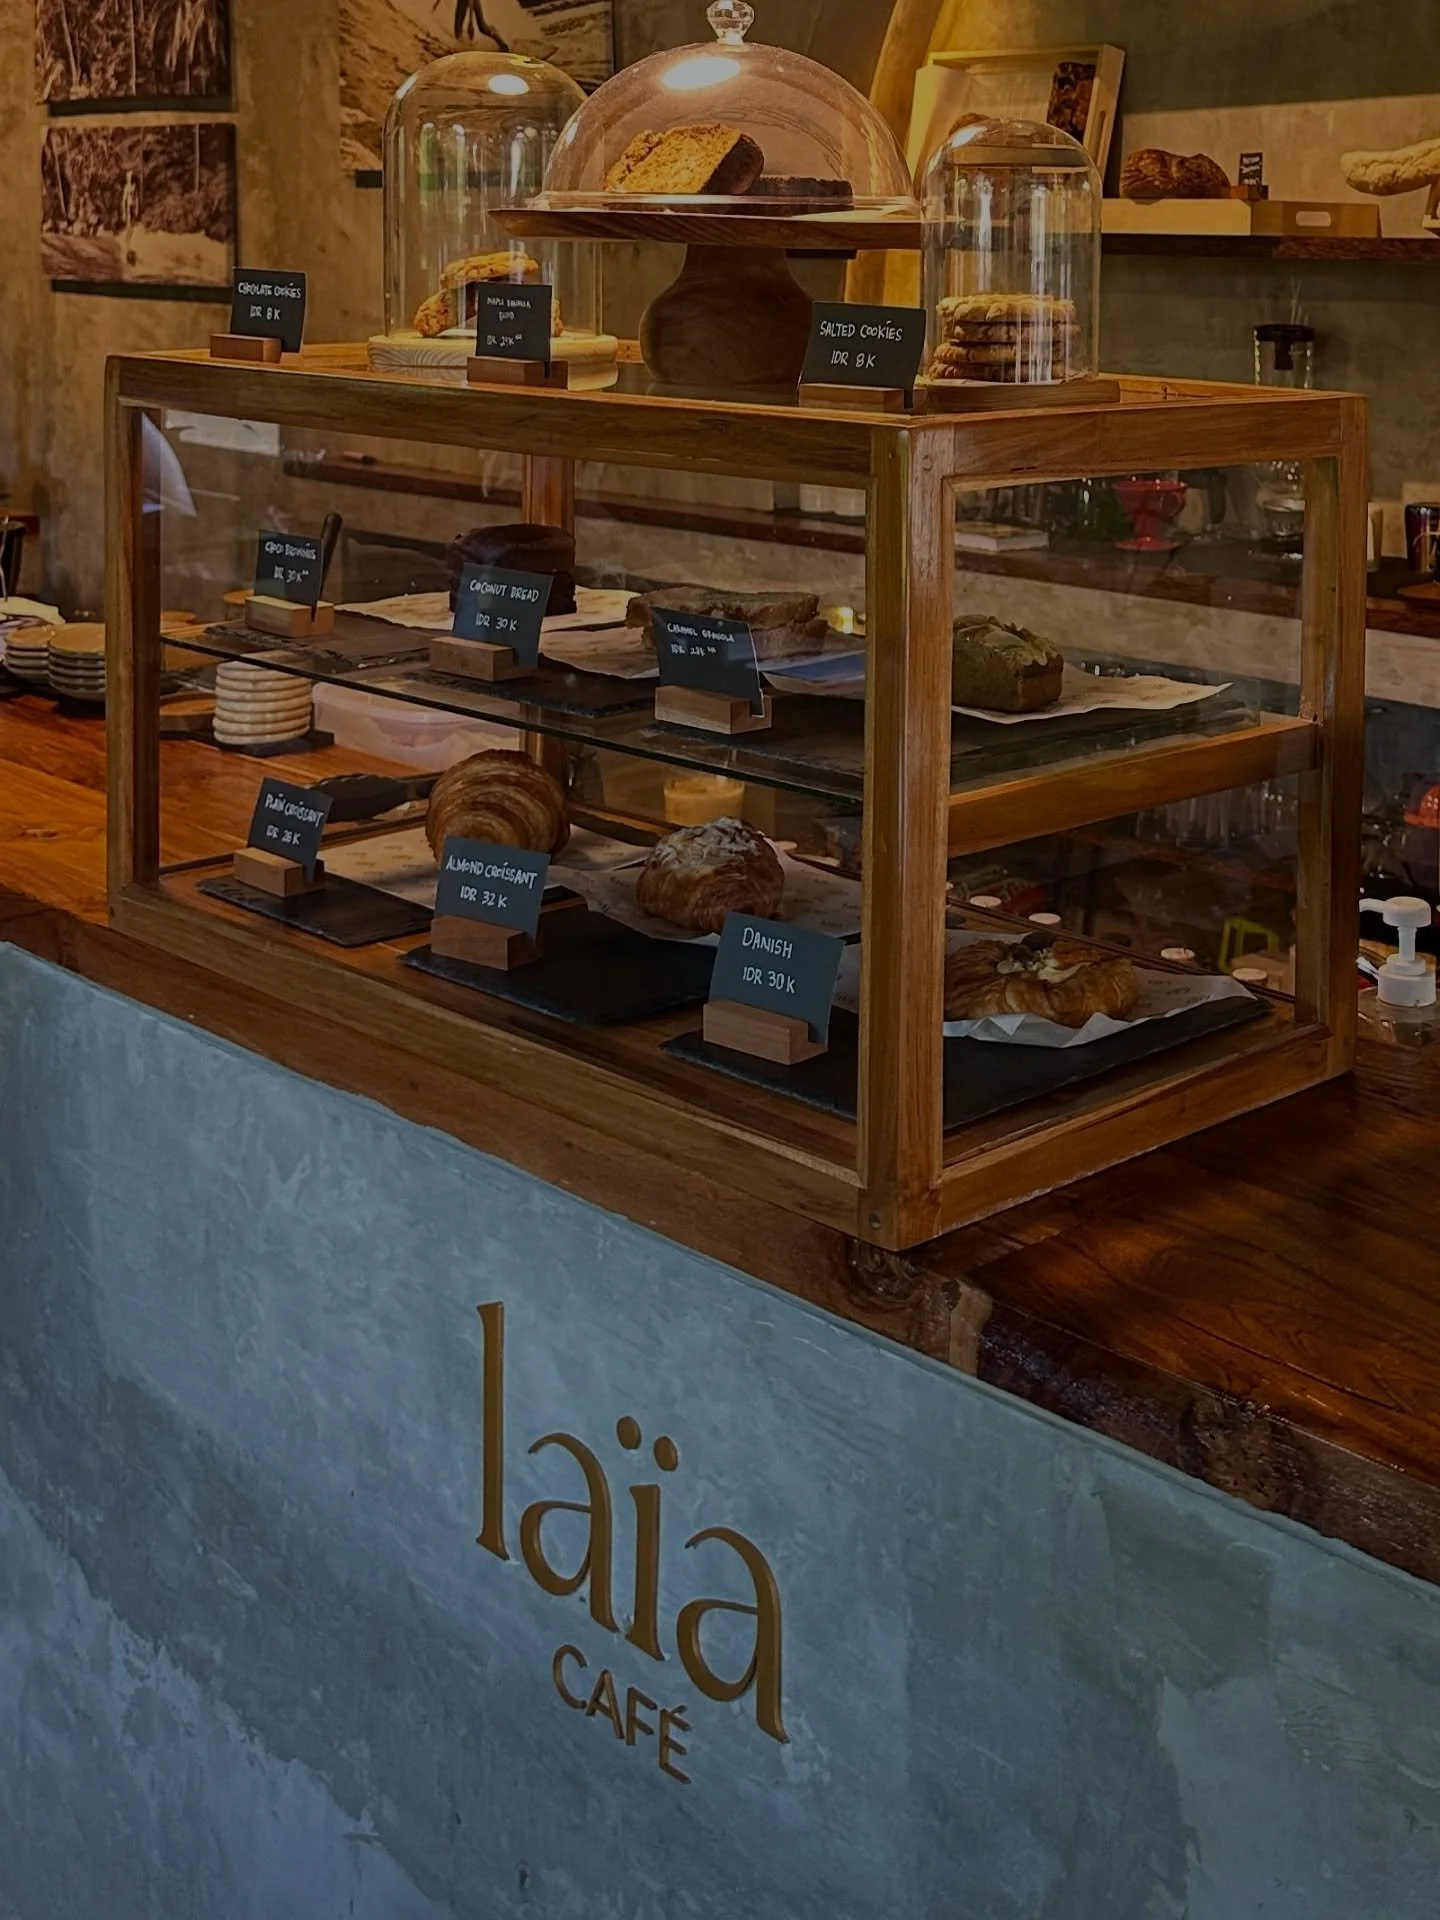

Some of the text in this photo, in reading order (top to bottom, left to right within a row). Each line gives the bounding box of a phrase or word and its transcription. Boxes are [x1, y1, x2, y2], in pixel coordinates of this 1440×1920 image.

[819, 320, 903, 342] SALTED COOKIES
[830, 350, 849, 366] IDR
[469, 579, 540, 603] COCONUT BREAD
[475, 612, 490, 627] IDR
[264, 793, 286, 812] PLAIN
[445, 854, 484, 876] ALMOND
[484, 861, 538, 890] CROISSANT
[459, 885, 478, 902] IDR
[741, 927, 793, 959] DANISH
[742, 966, 763, 985] IDR
[476, 1301, 790, 1744] laïa
[553, 1644, 692, 1784] CAFÉ
